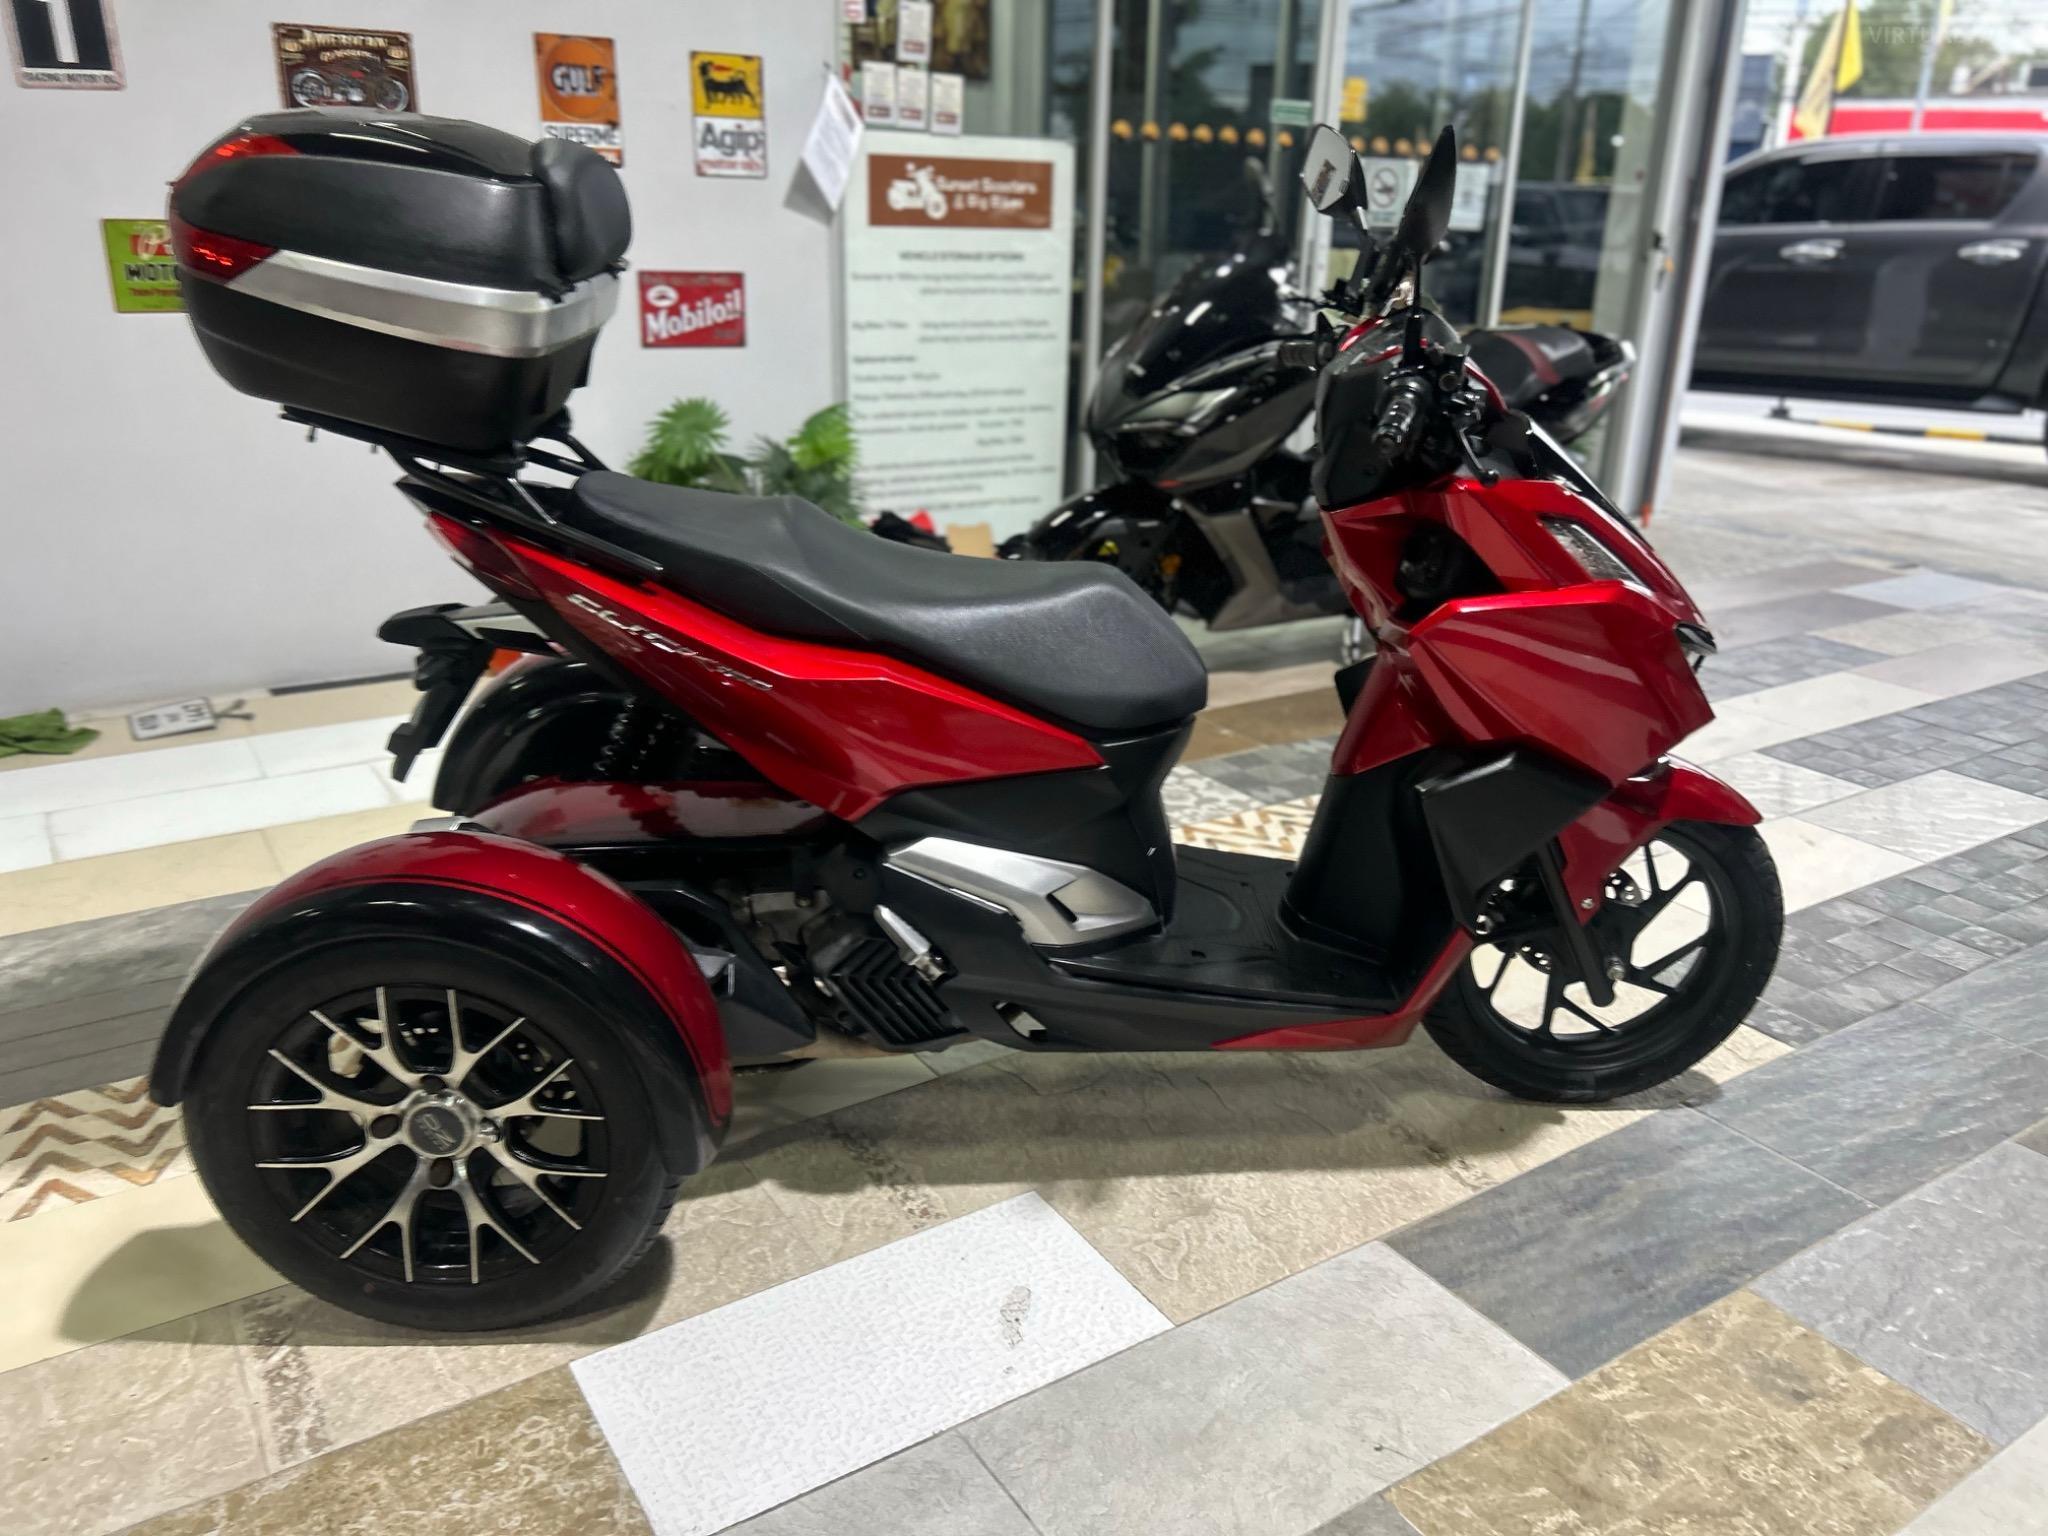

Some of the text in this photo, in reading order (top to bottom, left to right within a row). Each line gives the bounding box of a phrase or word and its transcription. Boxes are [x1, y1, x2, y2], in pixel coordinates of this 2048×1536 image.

[551, 63, 606, 96] GULF
[698, 122, 759, 158] Agip
[644, 288, 742, 344] Mobiloil
